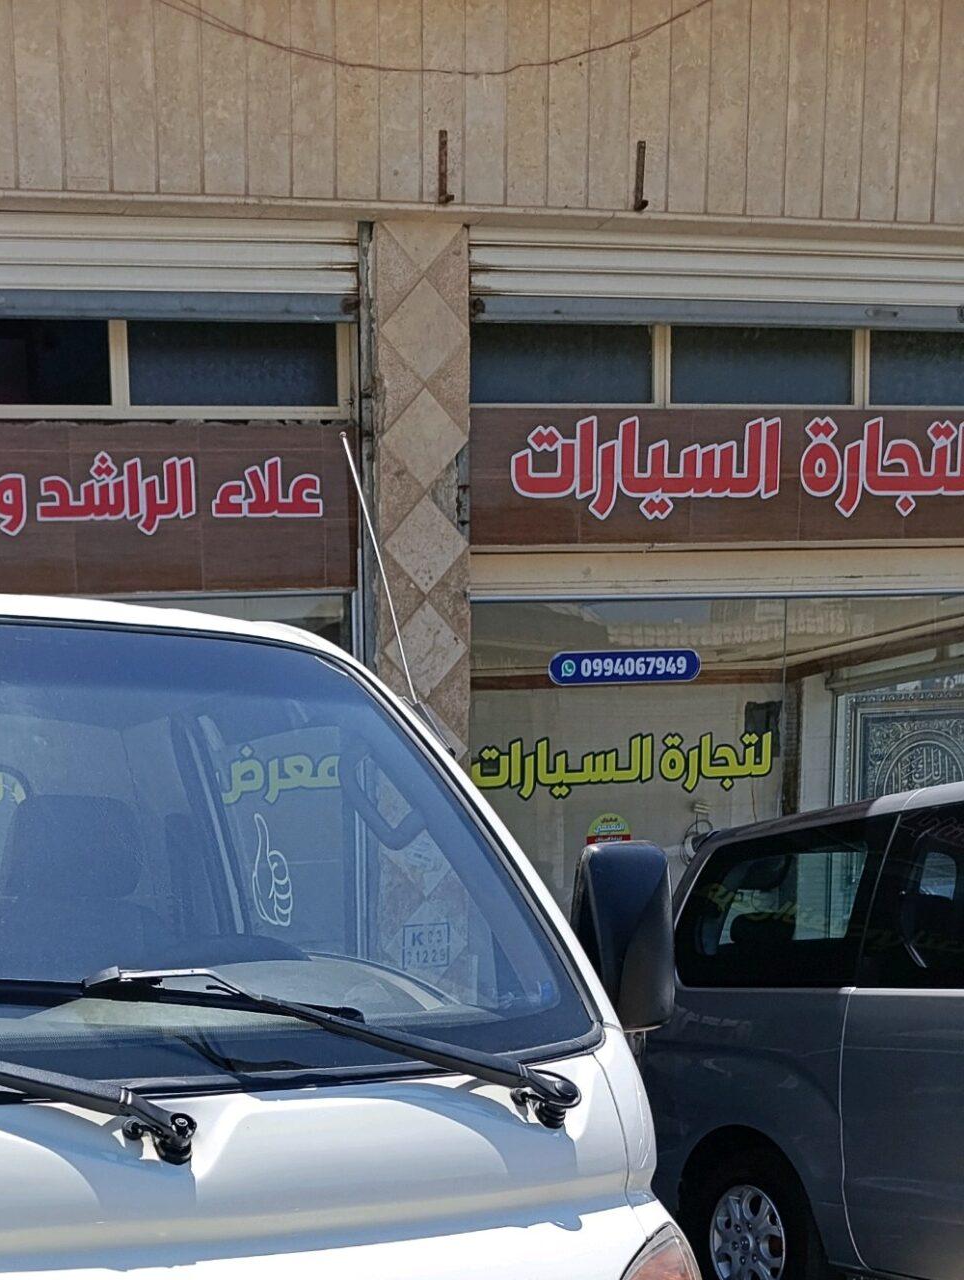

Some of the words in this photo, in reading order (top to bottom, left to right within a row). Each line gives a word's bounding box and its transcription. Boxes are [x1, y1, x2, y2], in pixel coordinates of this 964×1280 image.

[37, 451, 195, 535] الراشد
[212, 456, 323, 518] علاء
[511, 416, 782, 520] السيارات
[580, 655, 687, 678] 0994067949
[220, 745, 340, 804] معرض
[471, 733, 653, 800] السيارات
[659, 731, 773, 792] لتجارة
[411, 930, 424, 947] K
